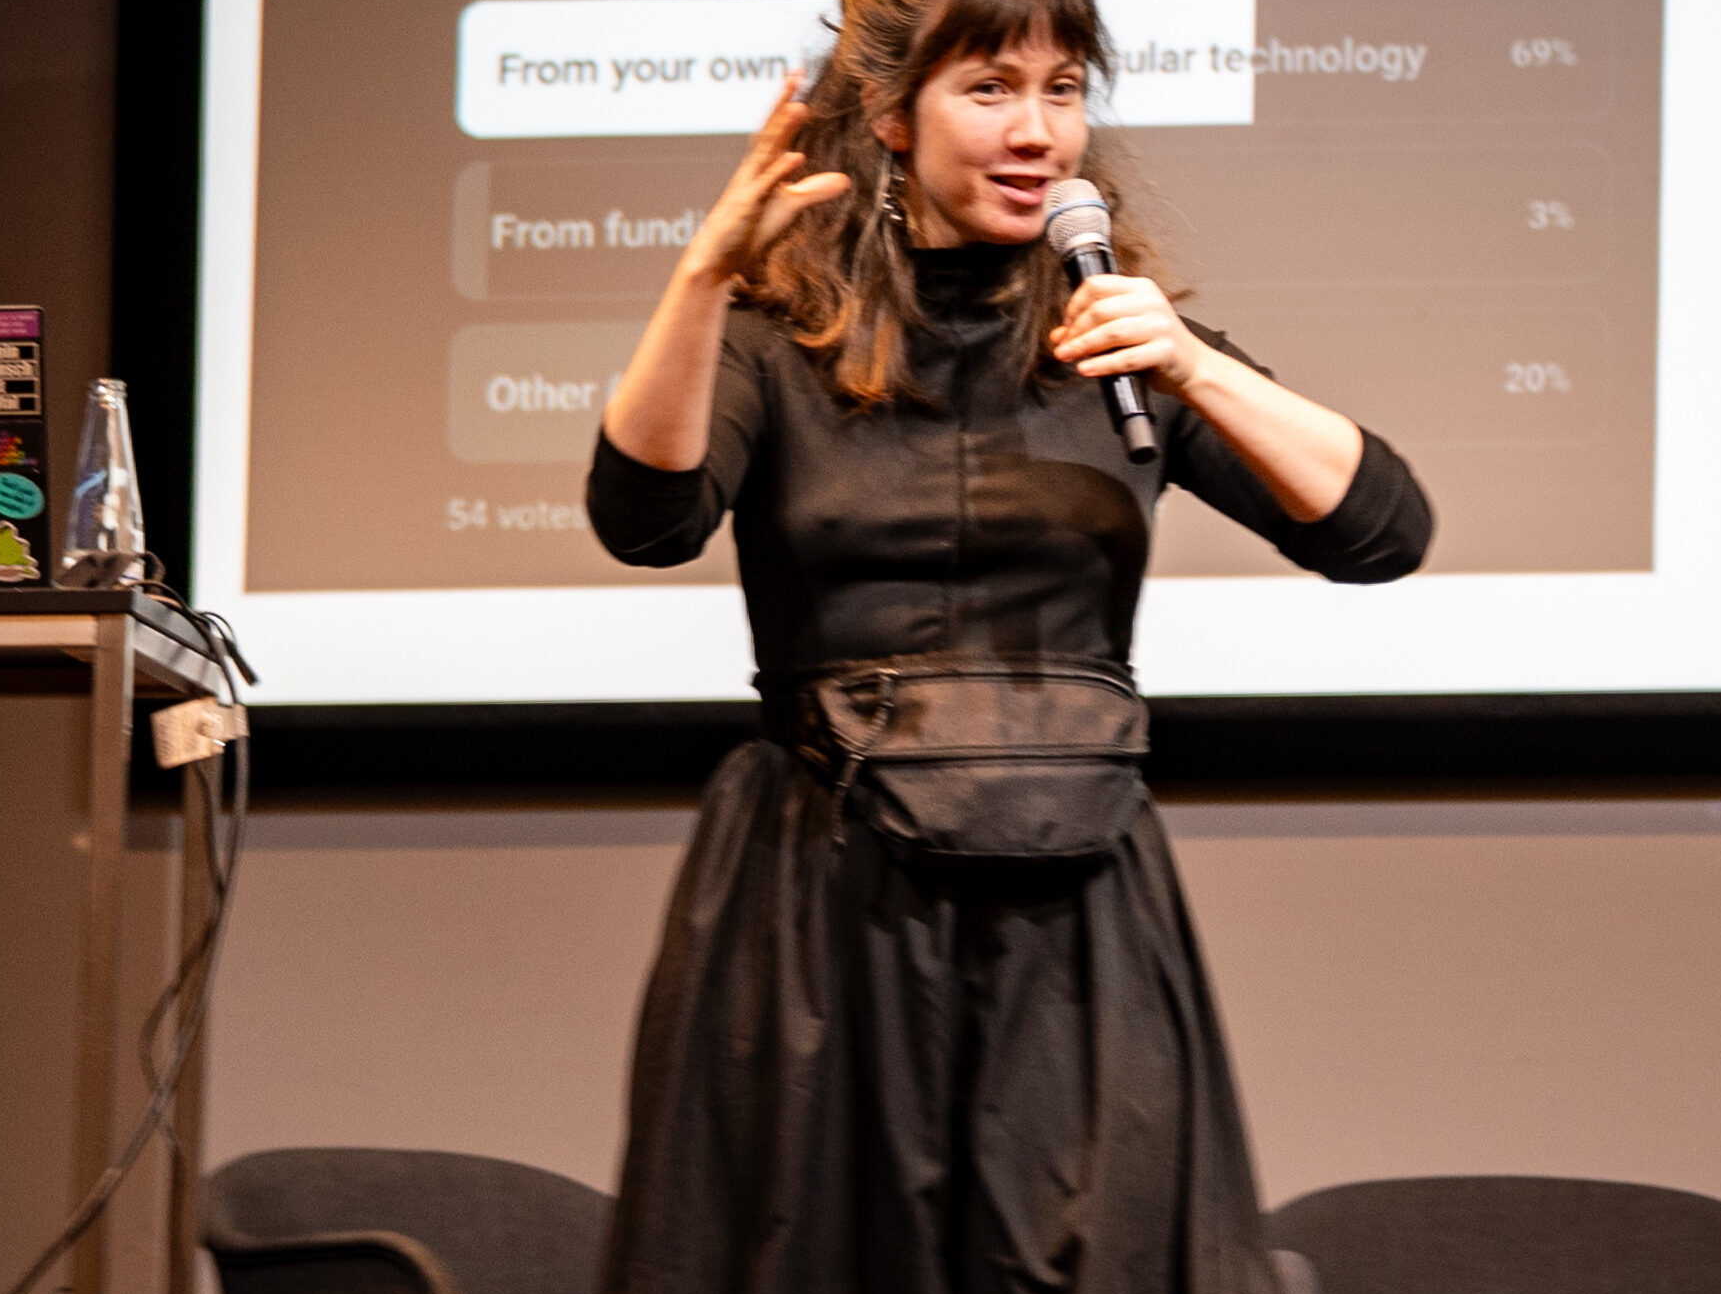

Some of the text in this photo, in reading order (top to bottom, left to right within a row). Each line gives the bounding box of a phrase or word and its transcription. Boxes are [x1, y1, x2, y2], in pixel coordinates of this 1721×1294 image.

[497, 51, 599, 87] From
[611, 53, 699, 93] your
[709, 53, 789, 83] own
[1123, 36, 1579, 81] ular technology 69%
[489, 214, 595, 250] From
[1527, 201, 1575, 231] 3%
[486, 374, 598, 413] Other
[1504, 362, 1572, 393] 20%
[445, 498, 489, 532] 54
